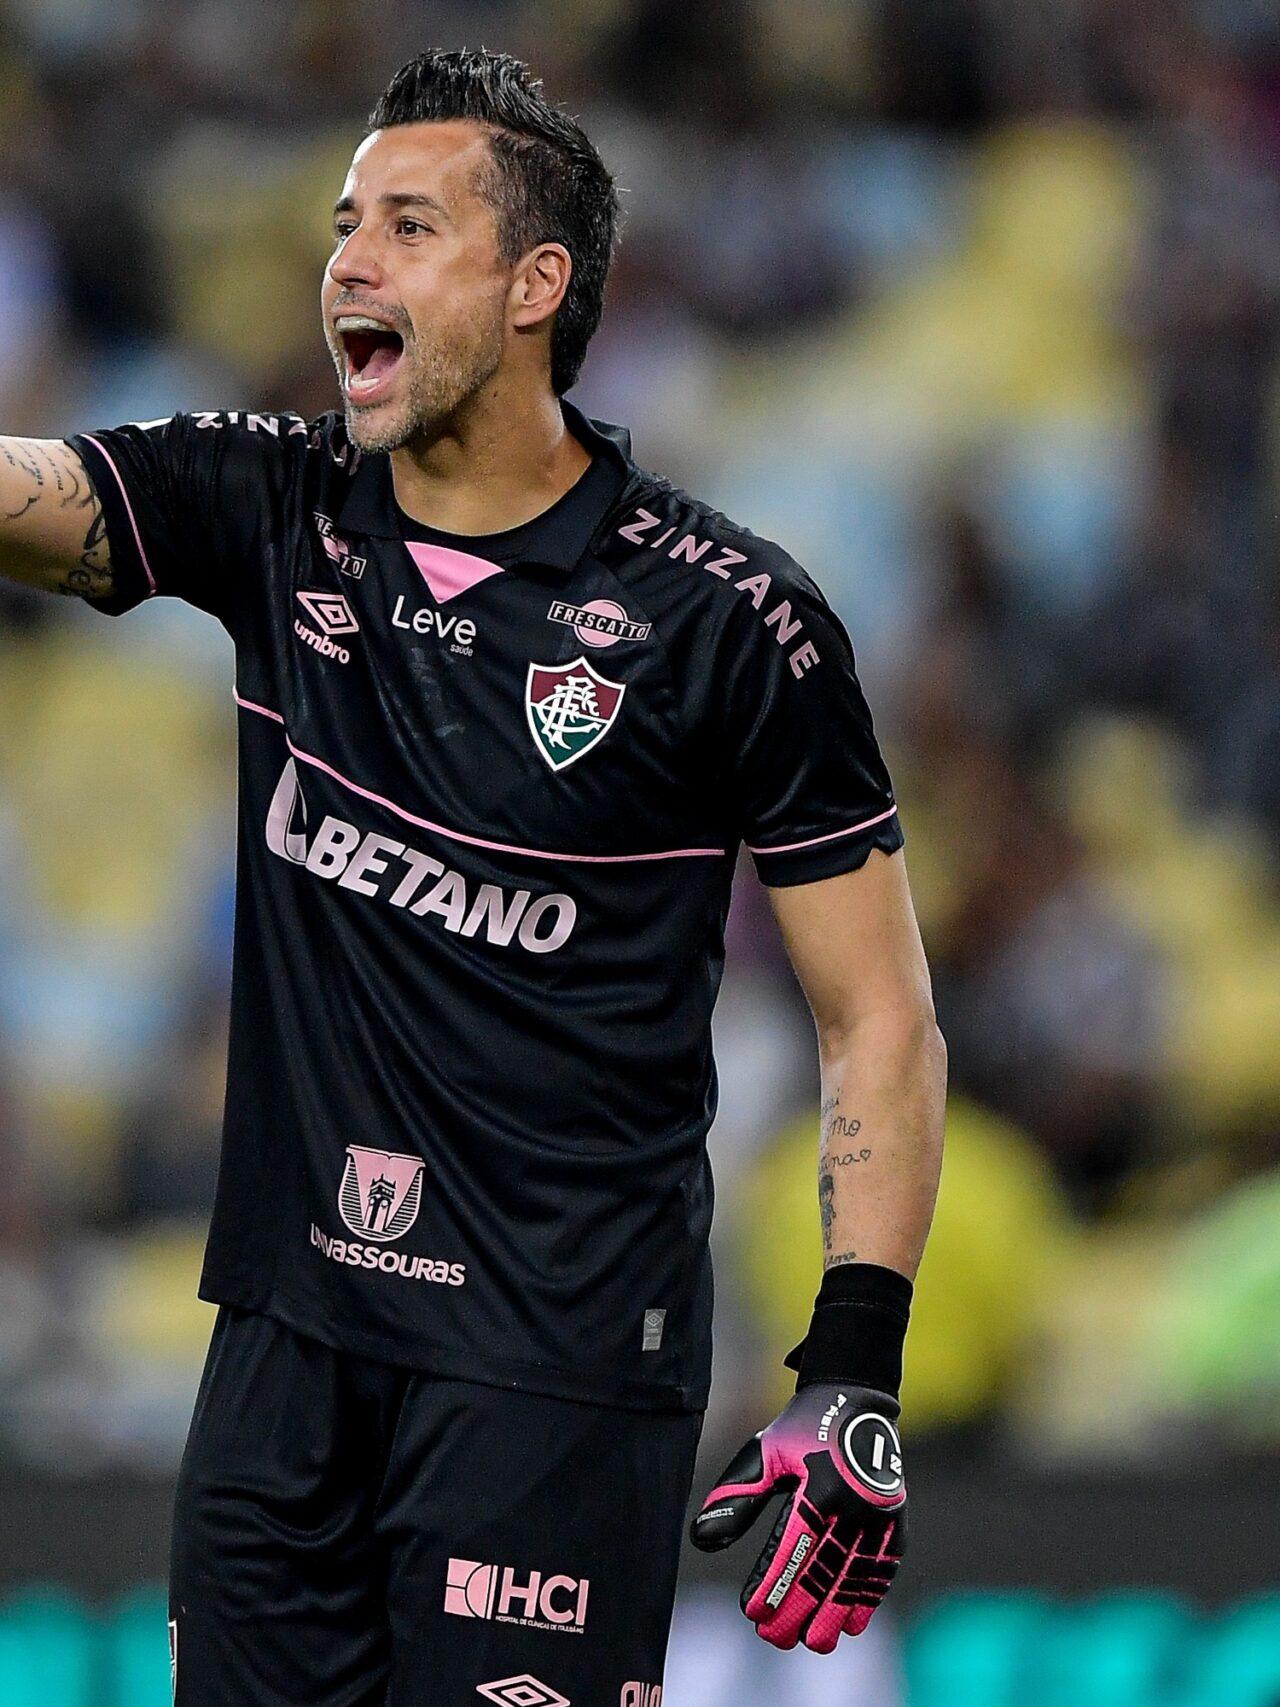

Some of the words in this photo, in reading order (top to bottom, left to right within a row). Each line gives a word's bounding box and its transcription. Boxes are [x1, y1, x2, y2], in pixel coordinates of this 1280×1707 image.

[618, 508, 821, 680] ZINZANE
[294, 619, 350, 664] umbro
[392, 595, 476, 645] Leve
[553, 605, 647, 638] FRESCATTO
[305, 815, 577, 953] BETANO
[782, 1534, 813, 1584] GOALKEEPER
[498, 1567, 590, 1626] HCI
